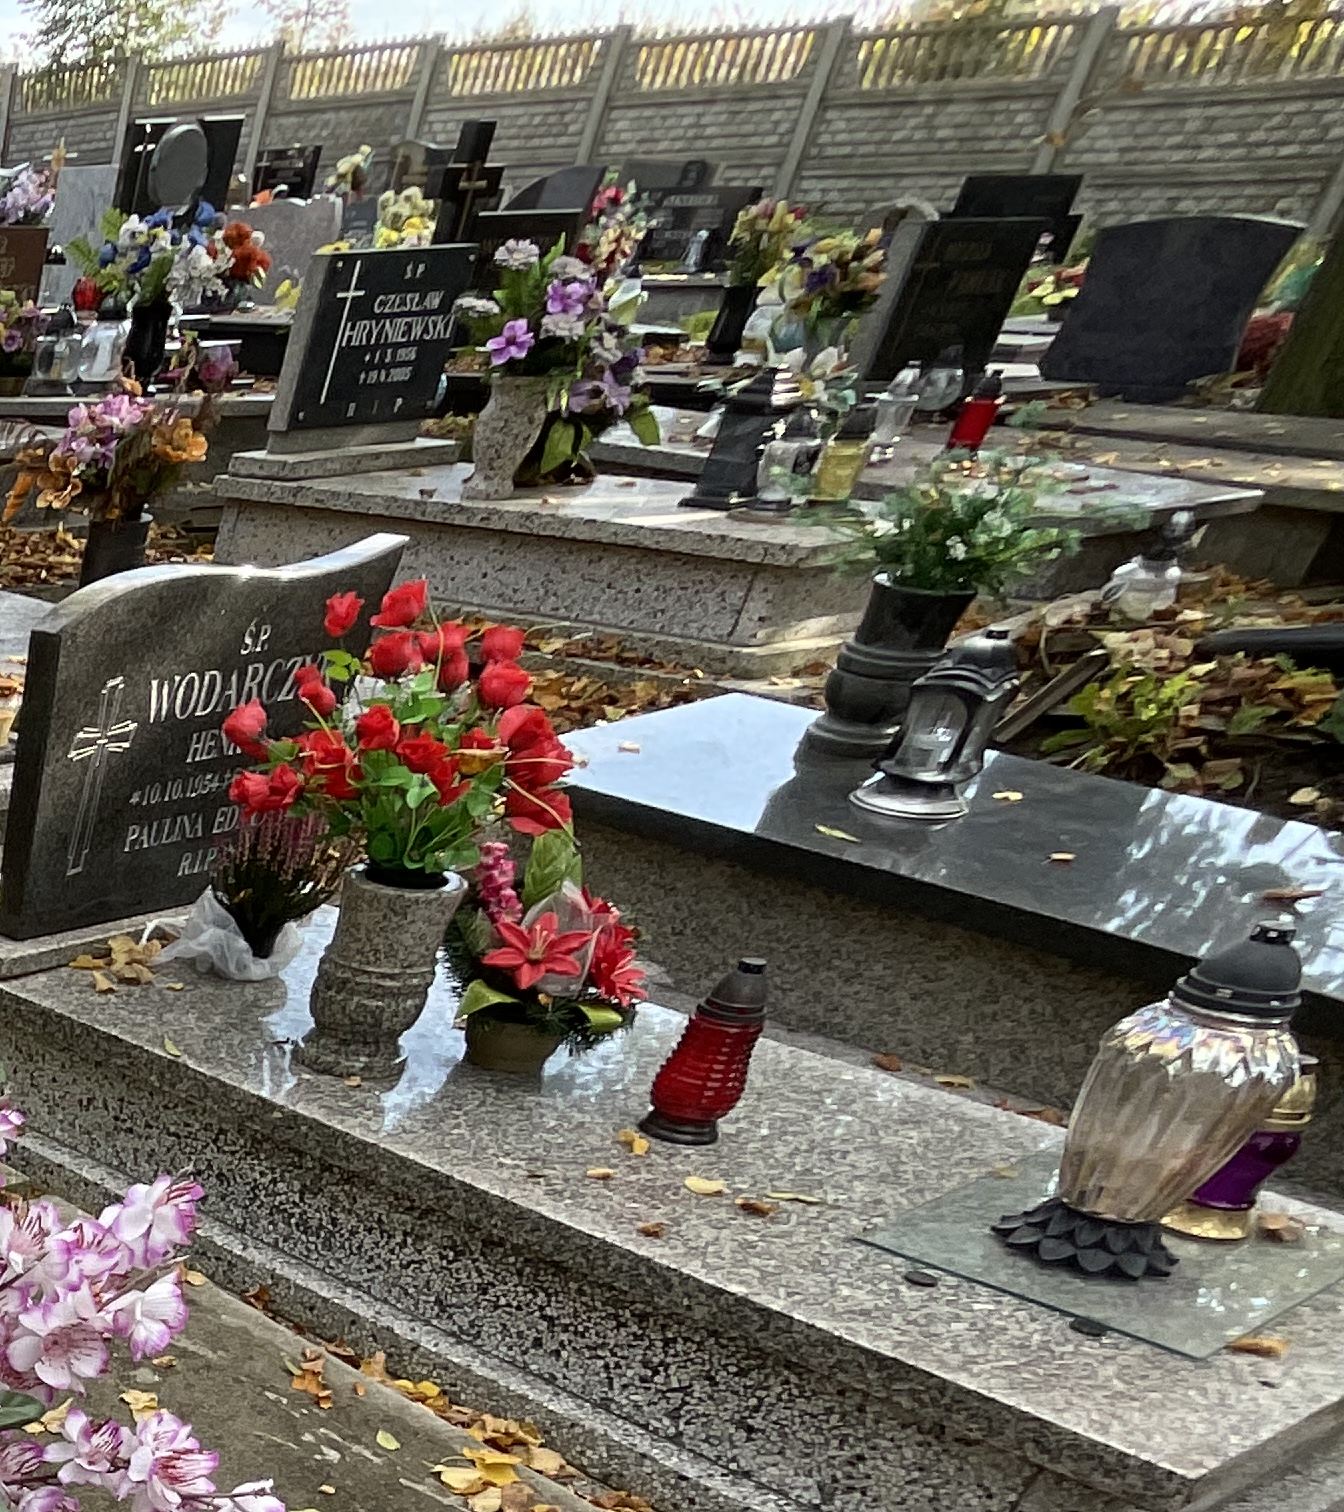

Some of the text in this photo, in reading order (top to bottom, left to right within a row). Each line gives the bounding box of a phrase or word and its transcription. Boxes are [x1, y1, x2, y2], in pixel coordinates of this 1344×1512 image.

[374, 291, 444, 313] CZESŁAW
[342, 313, 455, 347] HRYNIEWSKI
[124, 813, 203, 852] PAULINA
